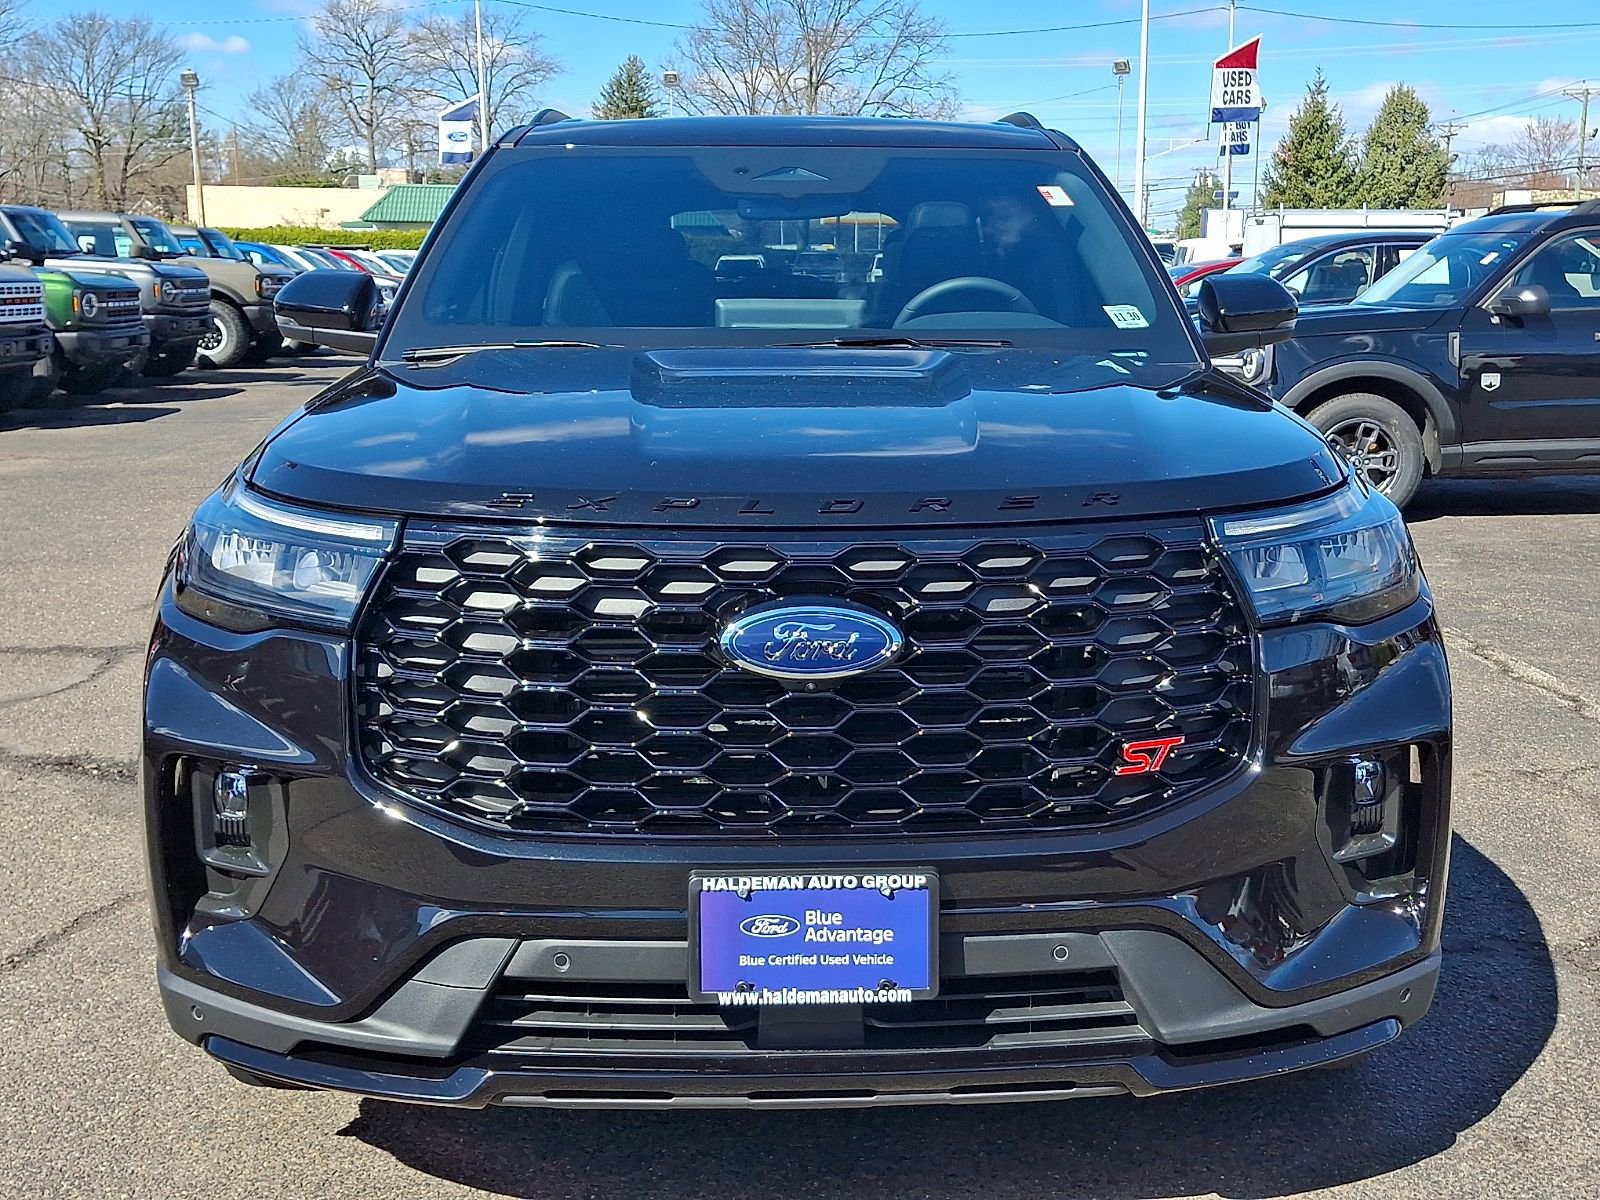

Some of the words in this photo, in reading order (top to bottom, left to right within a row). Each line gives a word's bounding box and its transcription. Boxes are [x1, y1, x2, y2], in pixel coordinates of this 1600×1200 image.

[1222, 70, 1252, 88] USED
[1222, 89, 1251, 105] CARS
[485, 491, 1120, 515] EXPLORER
[763, 621, 861, 661] Ford
[1114, 736, 1185, 775] ST
[702, 876, 804, 891] HALDEMAN
[807, 875, 858, 889] AUTO
[862, 875, 927, 889] GROUP
[750, 917, 790, 935] Ford
[804, 910, 843, 925] Blue
[804, 927, 895, 944] Advantage
[739, 955, 765, 966] Blue
[768, 953, 817, 966] Certified
[820, 953, 850, 965] Used
[852, 953, 895, 965] Vehicle
[717, 987, 913, 1006] www.haldemanauto.com
